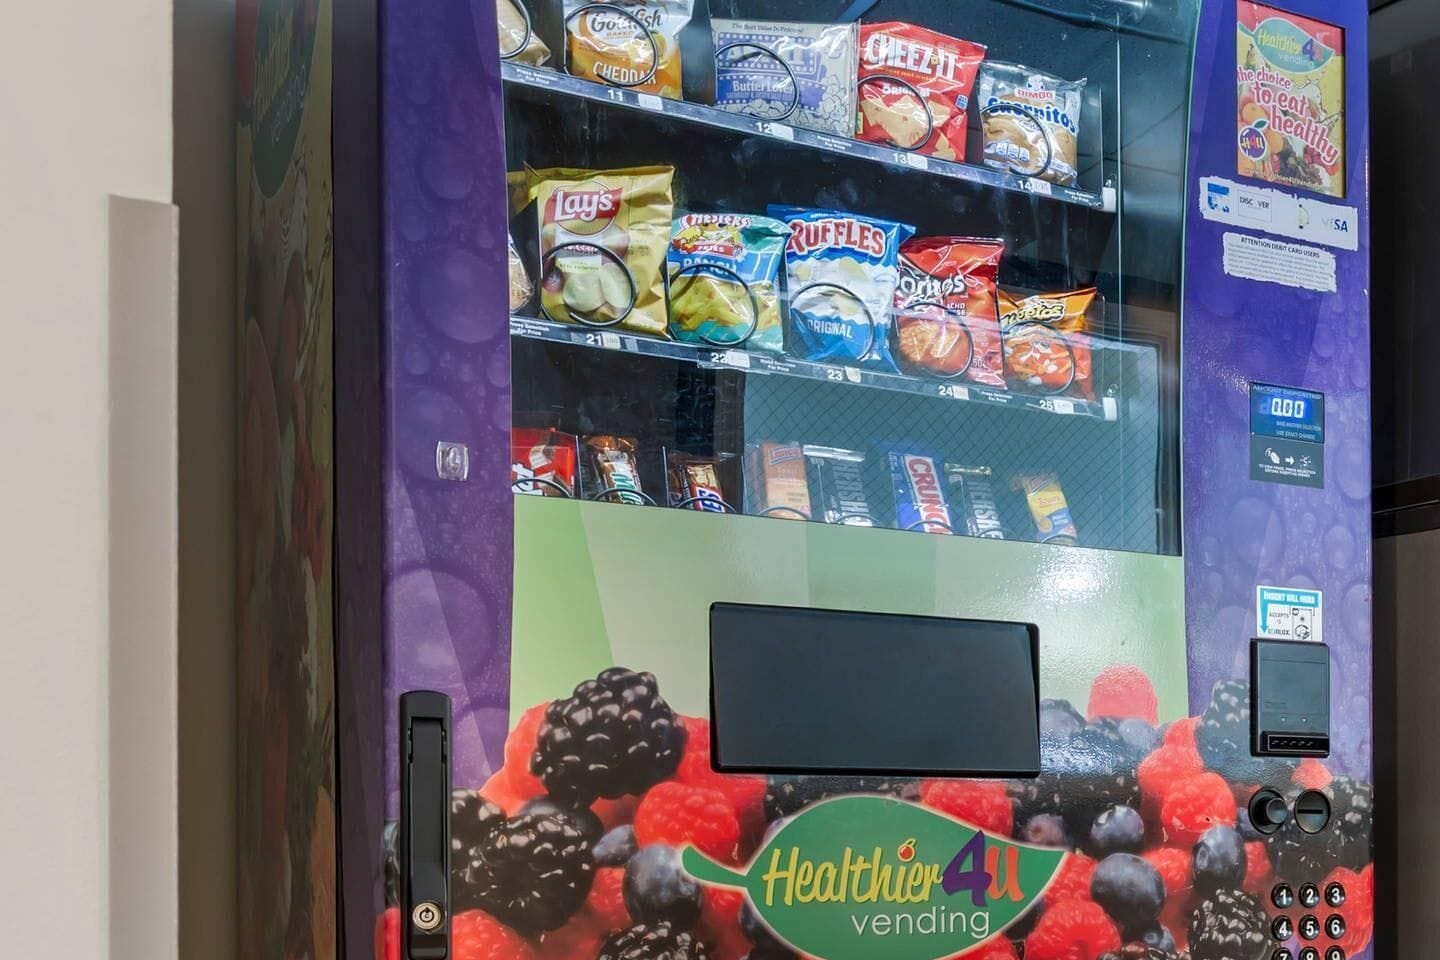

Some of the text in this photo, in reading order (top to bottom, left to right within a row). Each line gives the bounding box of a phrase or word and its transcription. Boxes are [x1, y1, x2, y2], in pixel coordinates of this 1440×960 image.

[1256, 66, 1292, 90] choice
[608, 89, 623, 102] 11
[1253, 82, 1308, 116] to eat
[755, 122, 771, 134] 12
[1271, 105, 1339, 164] healthy
[892, 152, 907, 164] 13
[1018, 180, 1033, 193] 14
[554, 188, 615, 222] Lay's
[1240, 196, 1270, 209] DISCVER
[787, 219, 885, 256] RUFFLES
[1241, 236, 1271, 249] ATTENTION
[1288, 246, 1302, 255] CARD
[1303, 249, 1320, 259] USERS
[894, 272, 965, 297] oritos
[586, 333, 602, 345] 21
[711, 351, 727, 363] 22
[827, 370, 843, 381] 23
[938, 386, 953, 396] 24
[1039, 400, 1053, 410] 25
[762, 843, 944, 907] Healthier
[1280, 888, 1340, 904] 1 2 3
[851, 906, 991, 939] vending
[1279, 920, 1340, 936] 4 5 6
